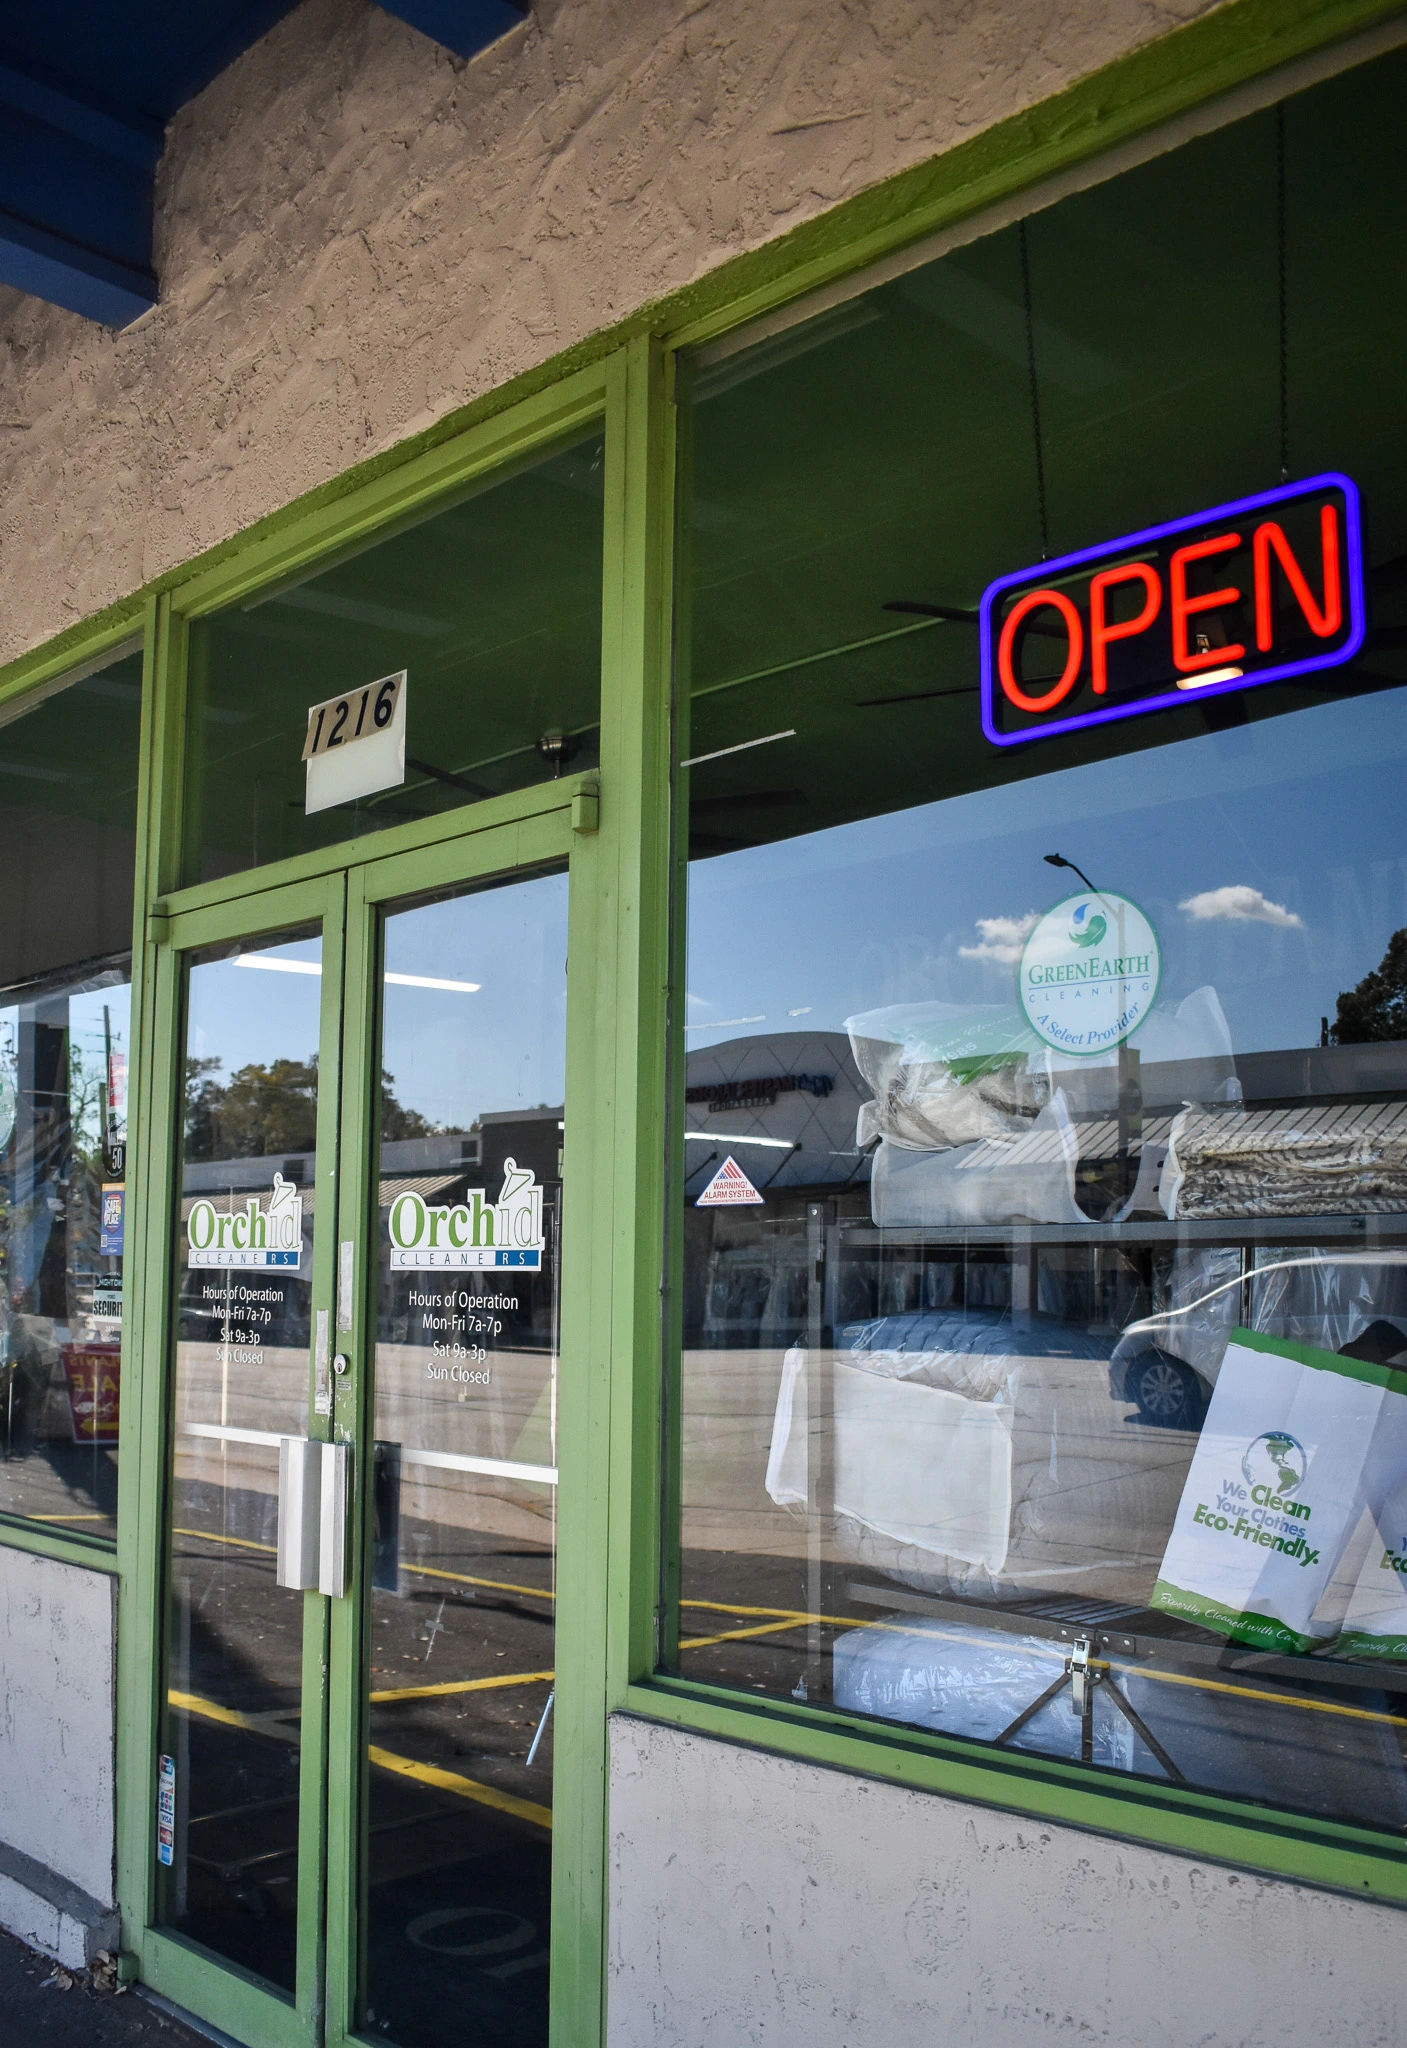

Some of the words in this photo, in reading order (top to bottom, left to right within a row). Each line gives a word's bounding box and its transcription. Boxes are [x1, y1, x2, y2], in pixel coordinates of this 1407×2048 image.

[999, 504, 1342, 713] OPEN
[312, 681, 395, 753] 1216
[1029, 983, 1150, 1003] CLEANING
[1037, 1014, 1049, 1026] A
[1047, 1021, 1084, 1044] Select
[1087, 1002, 1139, 1044] Provider
[112, 1147, 123, 1170] 50
[704, 1191, 728, 1199] ALARM
[728, 1190, 756, 1198] SYSTEM
[713, 1181, 747, 1190] WARNING!
[105, 1199, 120, 1213] SAFE
[106, 1213, 120, 1225] PLACE
[190, 1201, 300, 1249] Orchid
[392, 1191, 540, 1249] Orchid
[196, 1253, 288, 1264] CLEANERS
[400, 1252, 525, 1265] CLEANERS
[203, 1286, 227, 1300] Hours
[228, 1286, 238, 1300] of
[239, 1286, 284, 1304] Operation
[408, 1290, 442, 1307] Hours
[444, 1290, 457, 1307] of
[458, 1291, 519, 1312] Operation
[94, 1300, 123, 1317] SECURIT
[212, 1305, 245, 1320] Mon-Fri
[246, 1307, 272, 1325] 7a-7p
[422, 1313, 466, 1331] Mon-Fri
[468, 1315, 502, 1337] 7a-7p
[220, 1328, 234, 1342] Sat
[235, 1329, 261, 1347] 9a-3p
[233, 1348, 264, 1364] Closed
[433, 1340, 451, 1357] Sat
[453, 1342, 486, 1364] 9a-3p
[427, 1363, 448, 1380] Sun
[451, 1365, 490, 1385] Closed
[1222, 1479, 1248, 1501] We
[1250, 1484, 1312, 1522] Clean
[1215, 1494, 1249, 1518] Your
[1250, 1508, 1307, 1538] Clothes
[1192, 1503, 1321, 1568] Eco-Friendly.
[1160, 1592, 1201, 1617] Expertly
[1204, 1608, 1248, 1630] Cleaned
[1248, 1623, 1274, 1636] with
[161, 1814, 172, 1825] VISA
